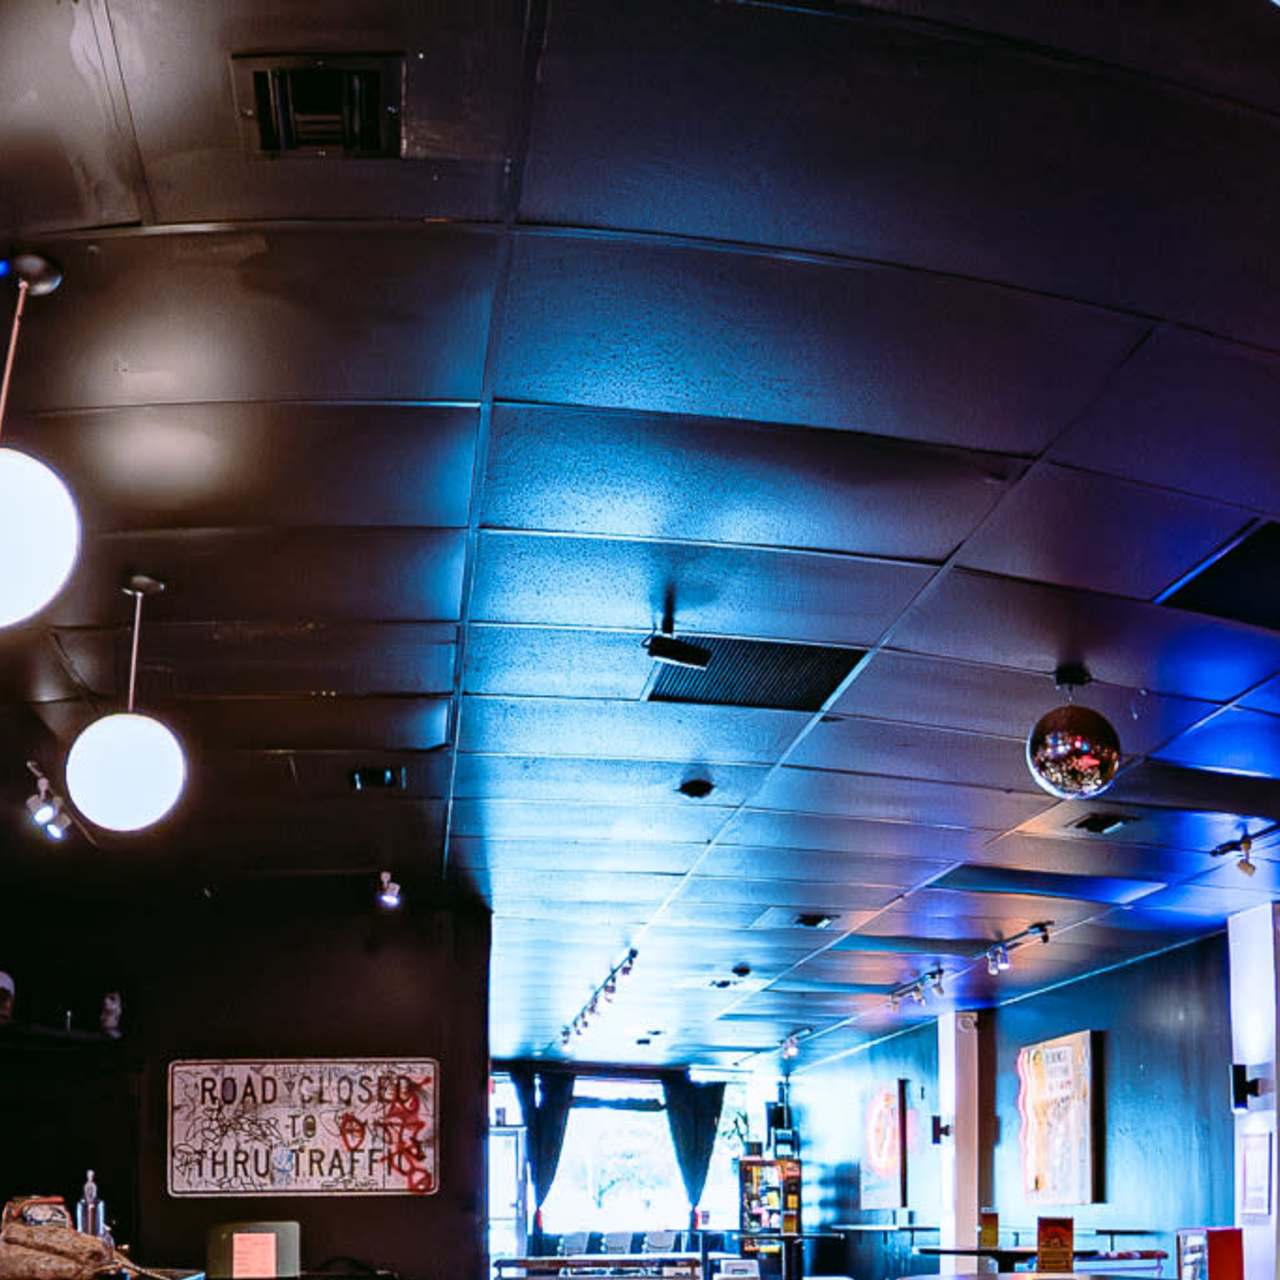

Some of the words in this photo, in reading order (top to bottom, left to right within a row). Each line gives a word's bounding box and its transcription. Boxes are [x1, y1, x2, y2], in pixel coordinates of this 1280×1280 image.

[200, 1075, 278, 1106] ROAD
[297, 1075, 413, 1105] CLOSED
[289, 1114, 317, 1138] TO
[194, 1149, 271, 1179] THRU
